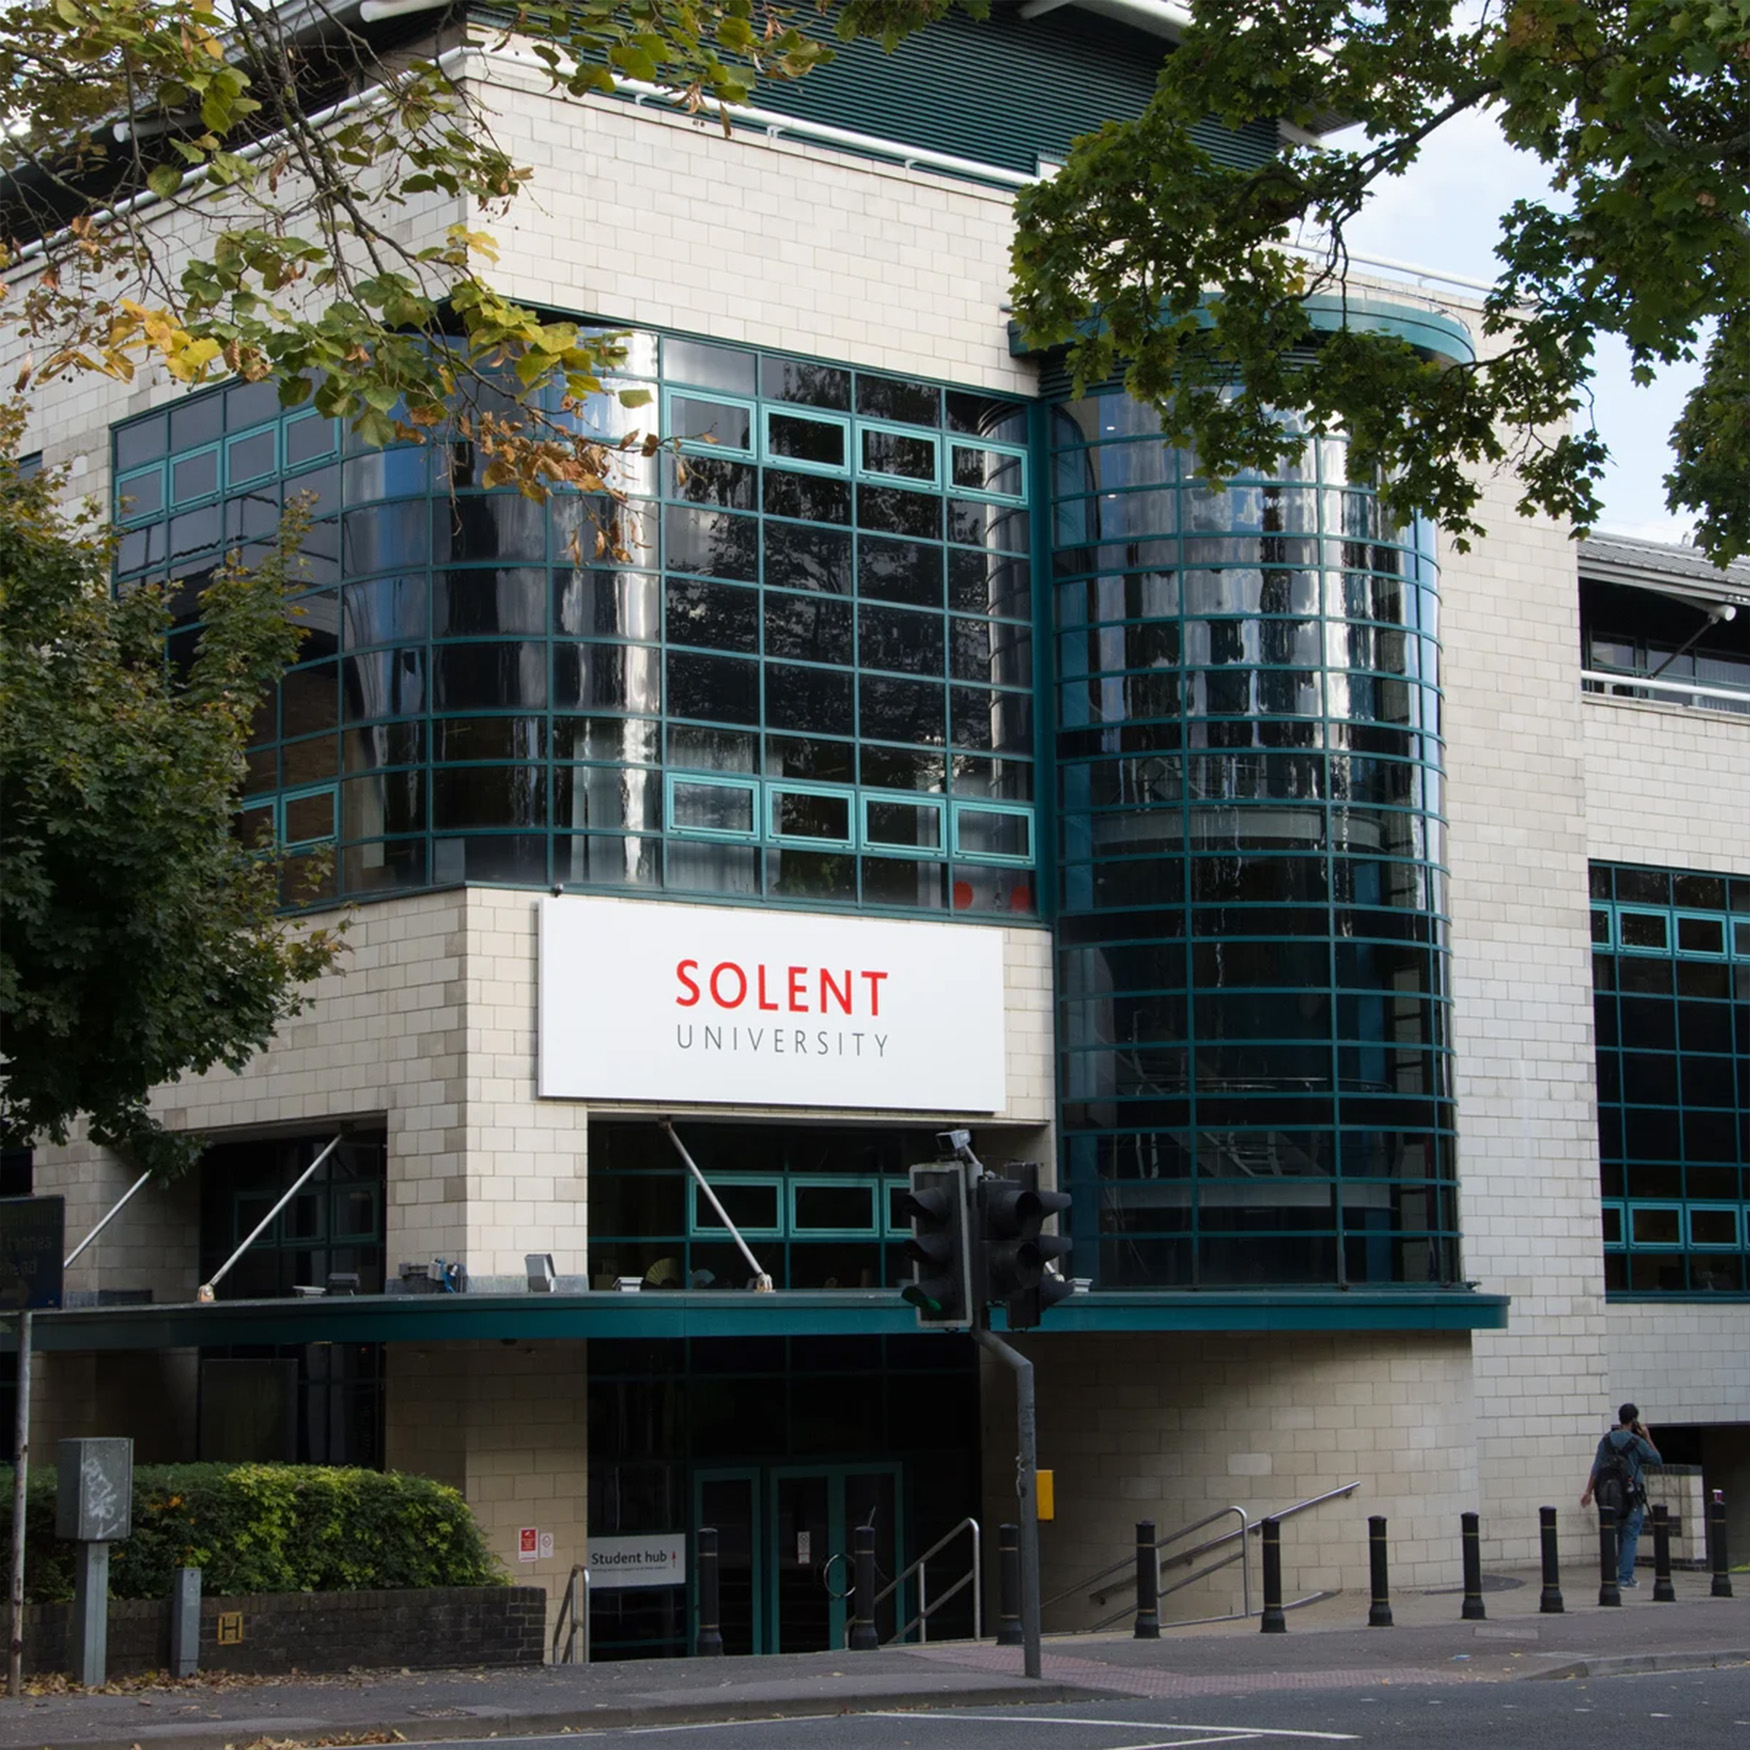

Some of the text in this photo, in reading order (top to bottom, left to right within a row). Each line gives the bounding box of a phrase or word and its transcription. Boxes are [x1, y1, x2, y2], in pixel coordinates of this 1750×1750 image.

[675, 958, 889, 1017] SOLENT
[677, 1024, 889, 1058] UNIVERSITY
[591, 1550, 668, 1565] Student hub
[222, 1616, 240, 1641] H
